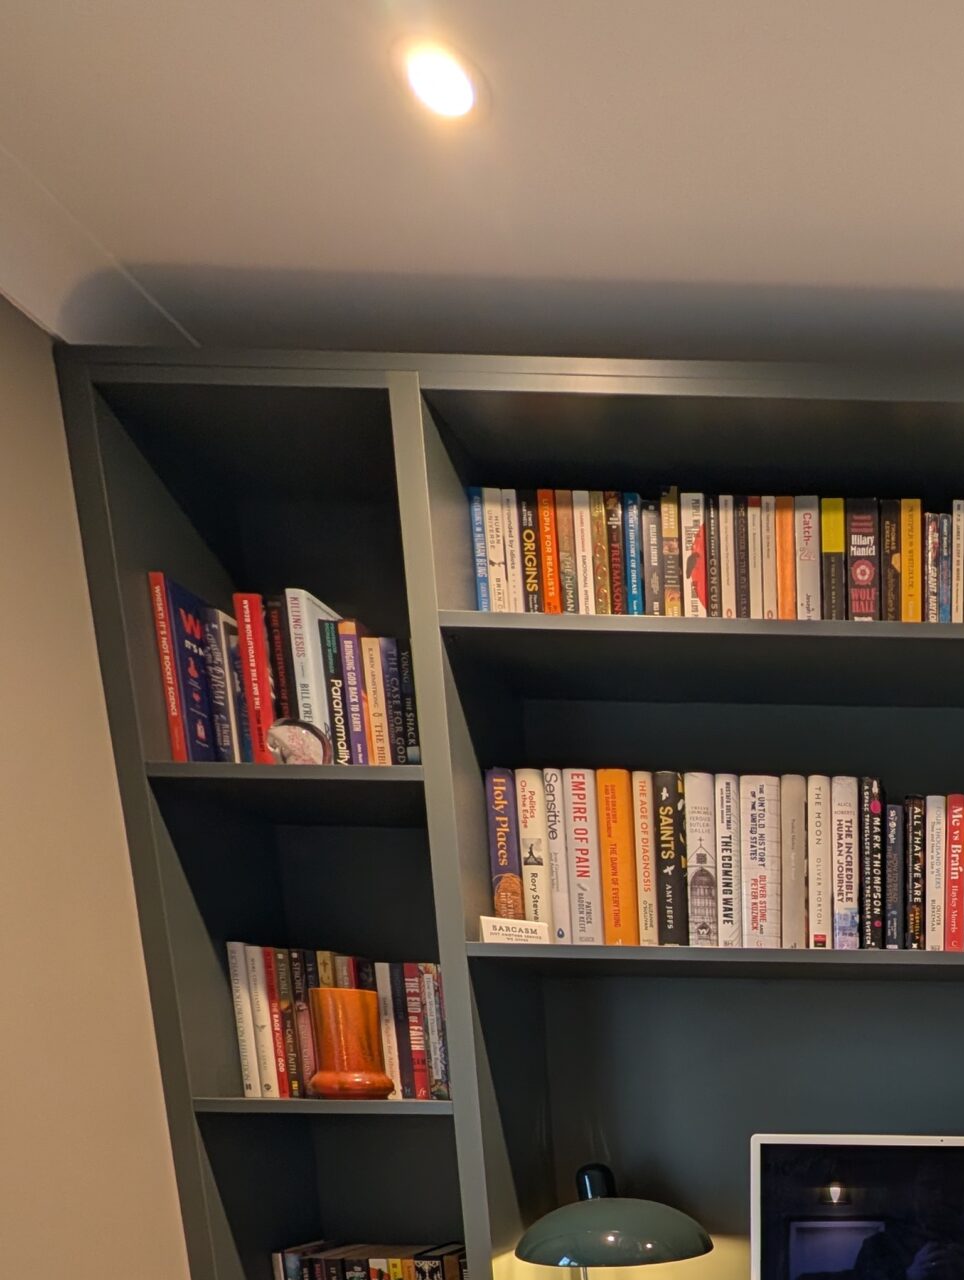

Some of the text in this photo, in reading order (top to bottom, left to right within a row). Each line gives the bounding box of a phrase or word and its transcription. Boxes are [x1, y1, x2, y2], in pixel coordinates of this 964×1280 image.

[487, 510, 496, 550] UNIVERSE
[542, 498, 555, 597] UTOPIA FOR REALISTS
[628, 530, 636, 558] HISTORY
[522, 529, 538, 592] ORIGINS
[630, 560, 636, 568] OF
[630, 570, 638, 594] DISEASE
[564, 560, 575, 612] THE HUMAN
[290, 596, 306, 658] KILLING JESUS
[343, 640, 362, 732] BRINGING GOD BACK TO EARTH
[400, 650, 410, 683] YOUNG
[300, 683, 311, 700] BILL
[388, 649, 407, 763] THE CASE FOR GOD
[330, 679, 353, 765] Paranormality
[374, 722, 384, 744] THE
[520, 780, 527, 792] On
[520, 794, 528, 808] the
[528, 790, 536, 818] Politics
[544, 772, 560, 840] Sensitive
[814, 786, 822, 806] THE
[492, 777, 510, 866] Holy Places
[570, 772, 590, 878] EMPIRE OF PAIN
[639, 780, 652, 892] THE AGE OF DIAGNOSIS
[659, 806, 674, 860] SAINTS
[950, 806, 964, 880] Me vs Brain
[844, 818, 854, 902] THE INCREDIBLE
[873, 817, 882, 915] MARK THOMPSON
[914, 806, 922, 902] ALL THAT WE ARE
[720, 834, 734, 925] THE COMING WAVE
[950, 884, 958, 908] Hayley
[492, 925, 538, 935] SARCASM
[666, 905, 674, 929] JEFFS
[278, 963, 288, 994] STROBEL
[292, 962, 302, 994] STROBEL
[285, 1028, 294, 1044] CASE
[405, 976, 425, 1051] THE END OF FAITH
[288, 1052, 297, 1074] FAITH
